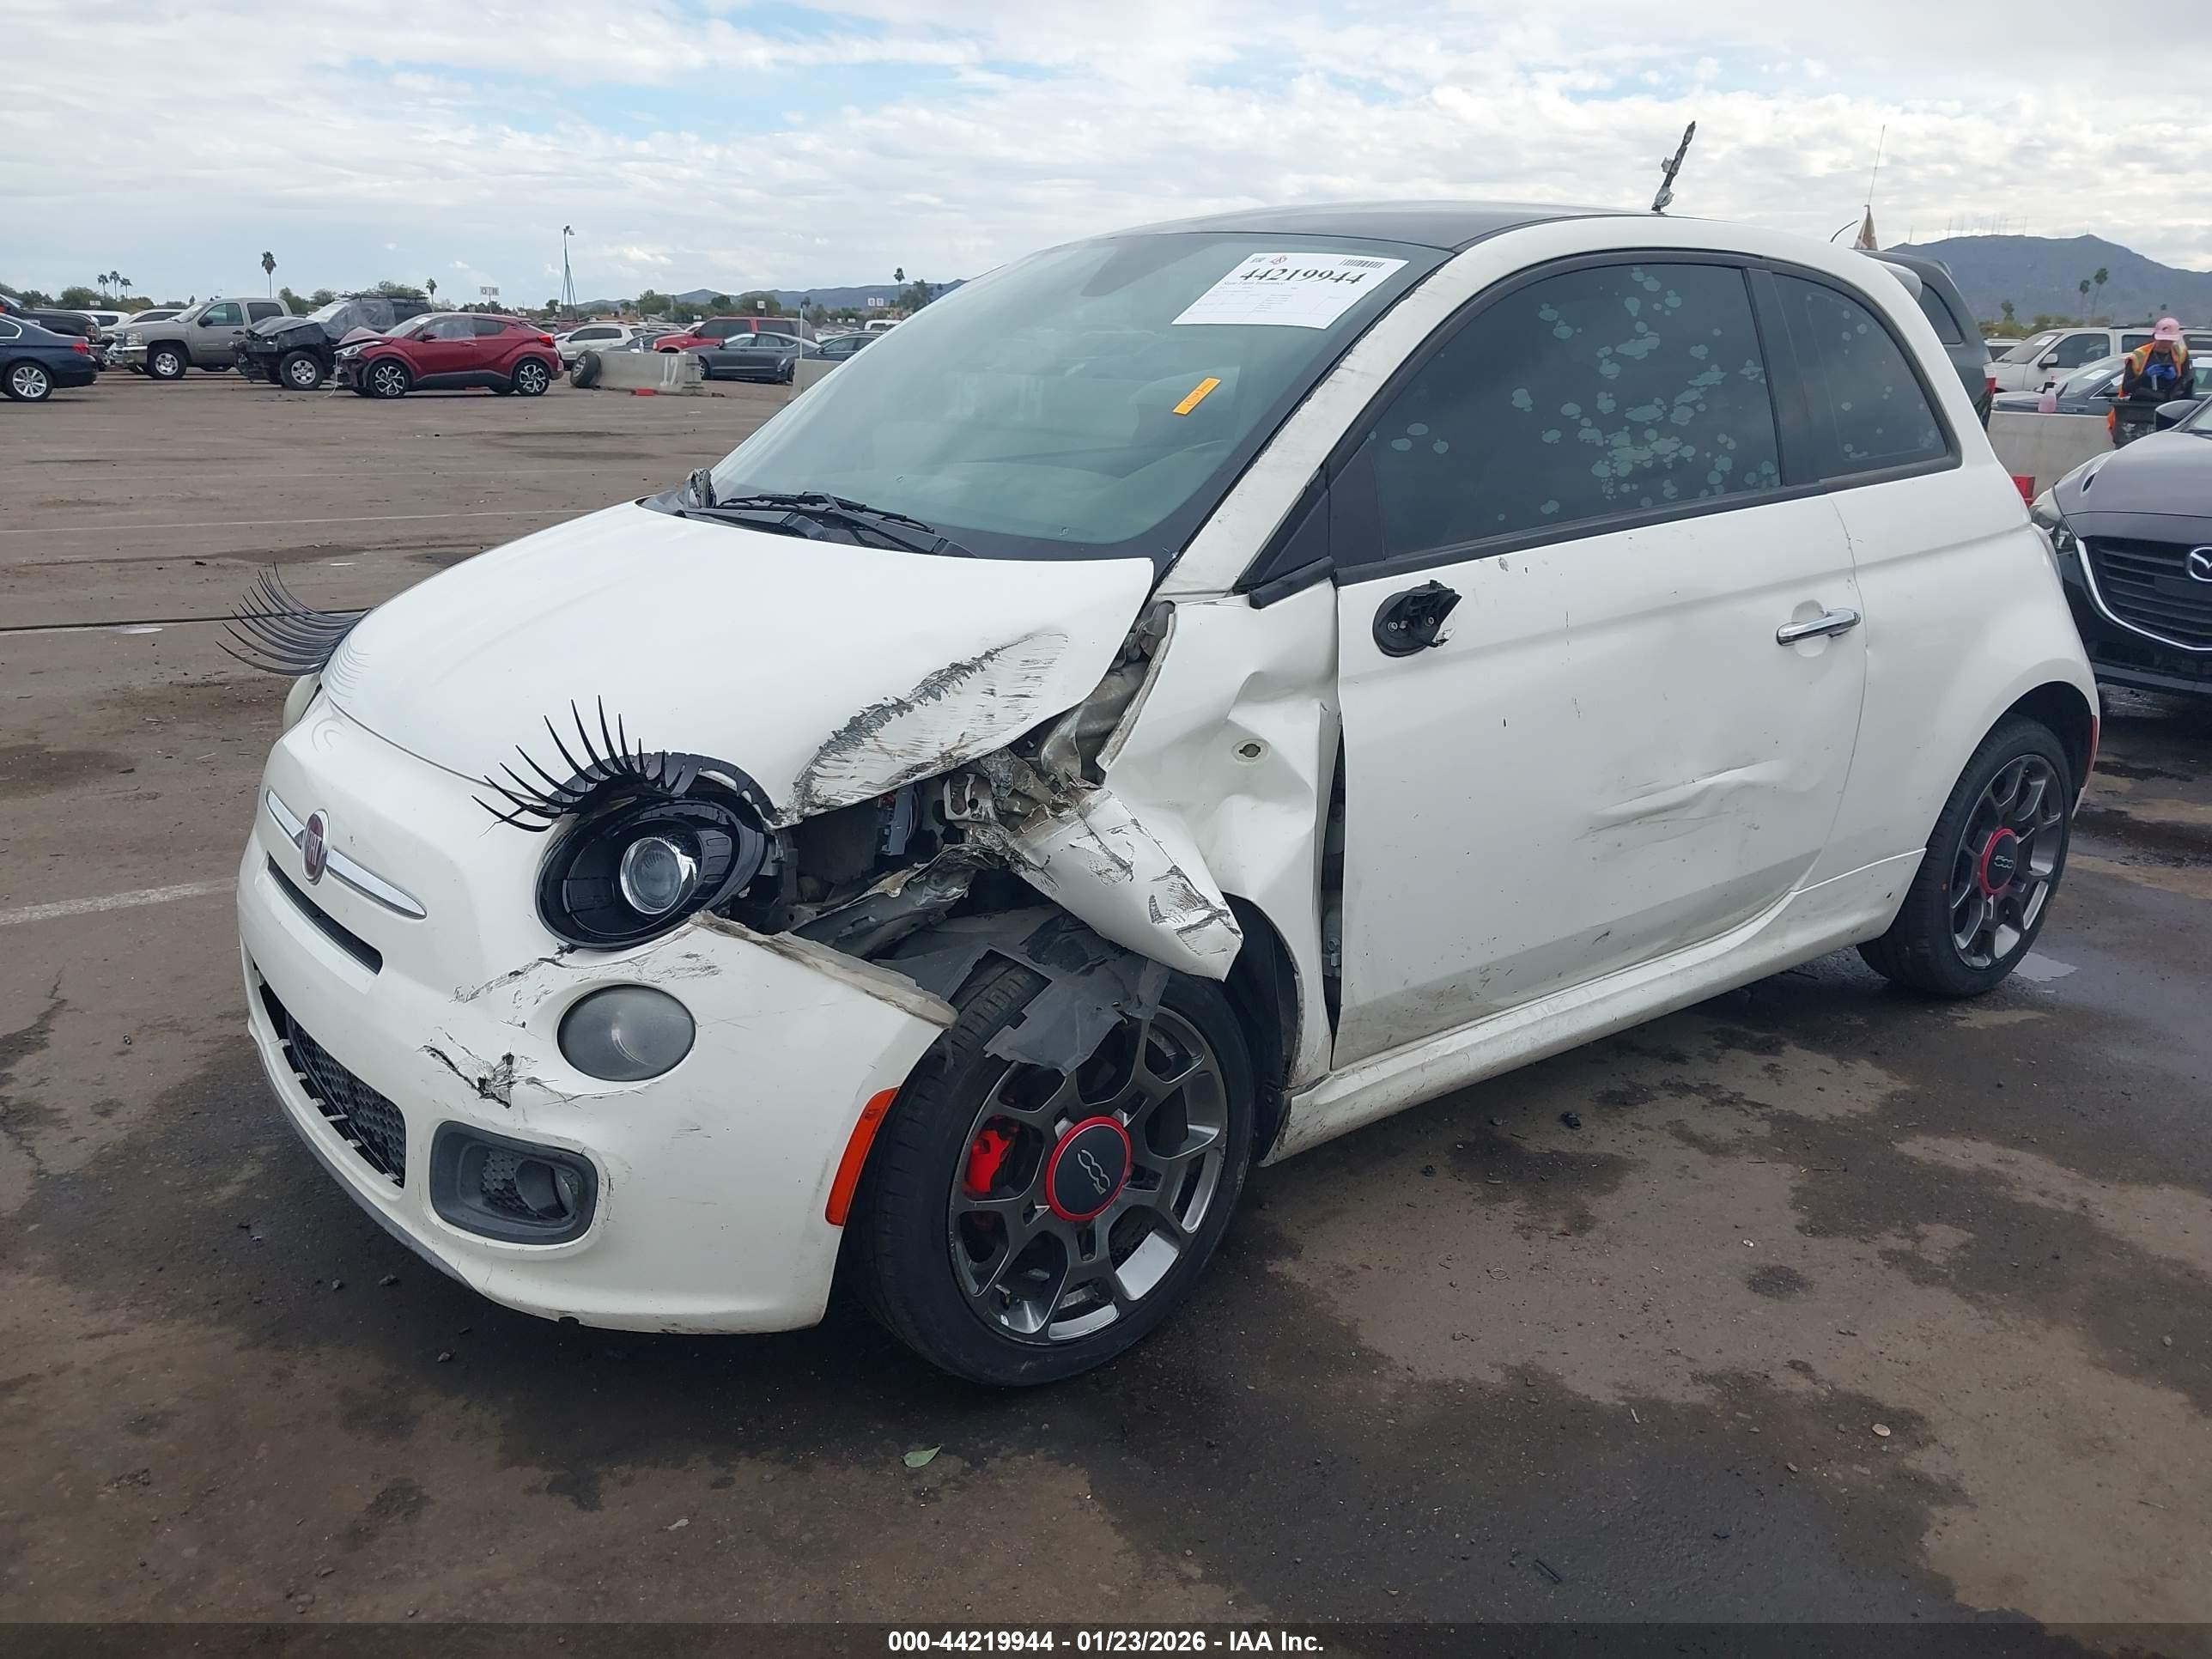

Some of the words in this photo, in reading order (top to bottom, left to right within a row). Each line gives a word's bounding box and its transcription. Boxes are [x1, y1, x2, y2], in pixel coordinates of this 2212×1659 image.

[1240, 268, 1367, 284] 44219944
[659, 356, 678, 386] 17
[1078, 1149, 1110, 1194] 500
